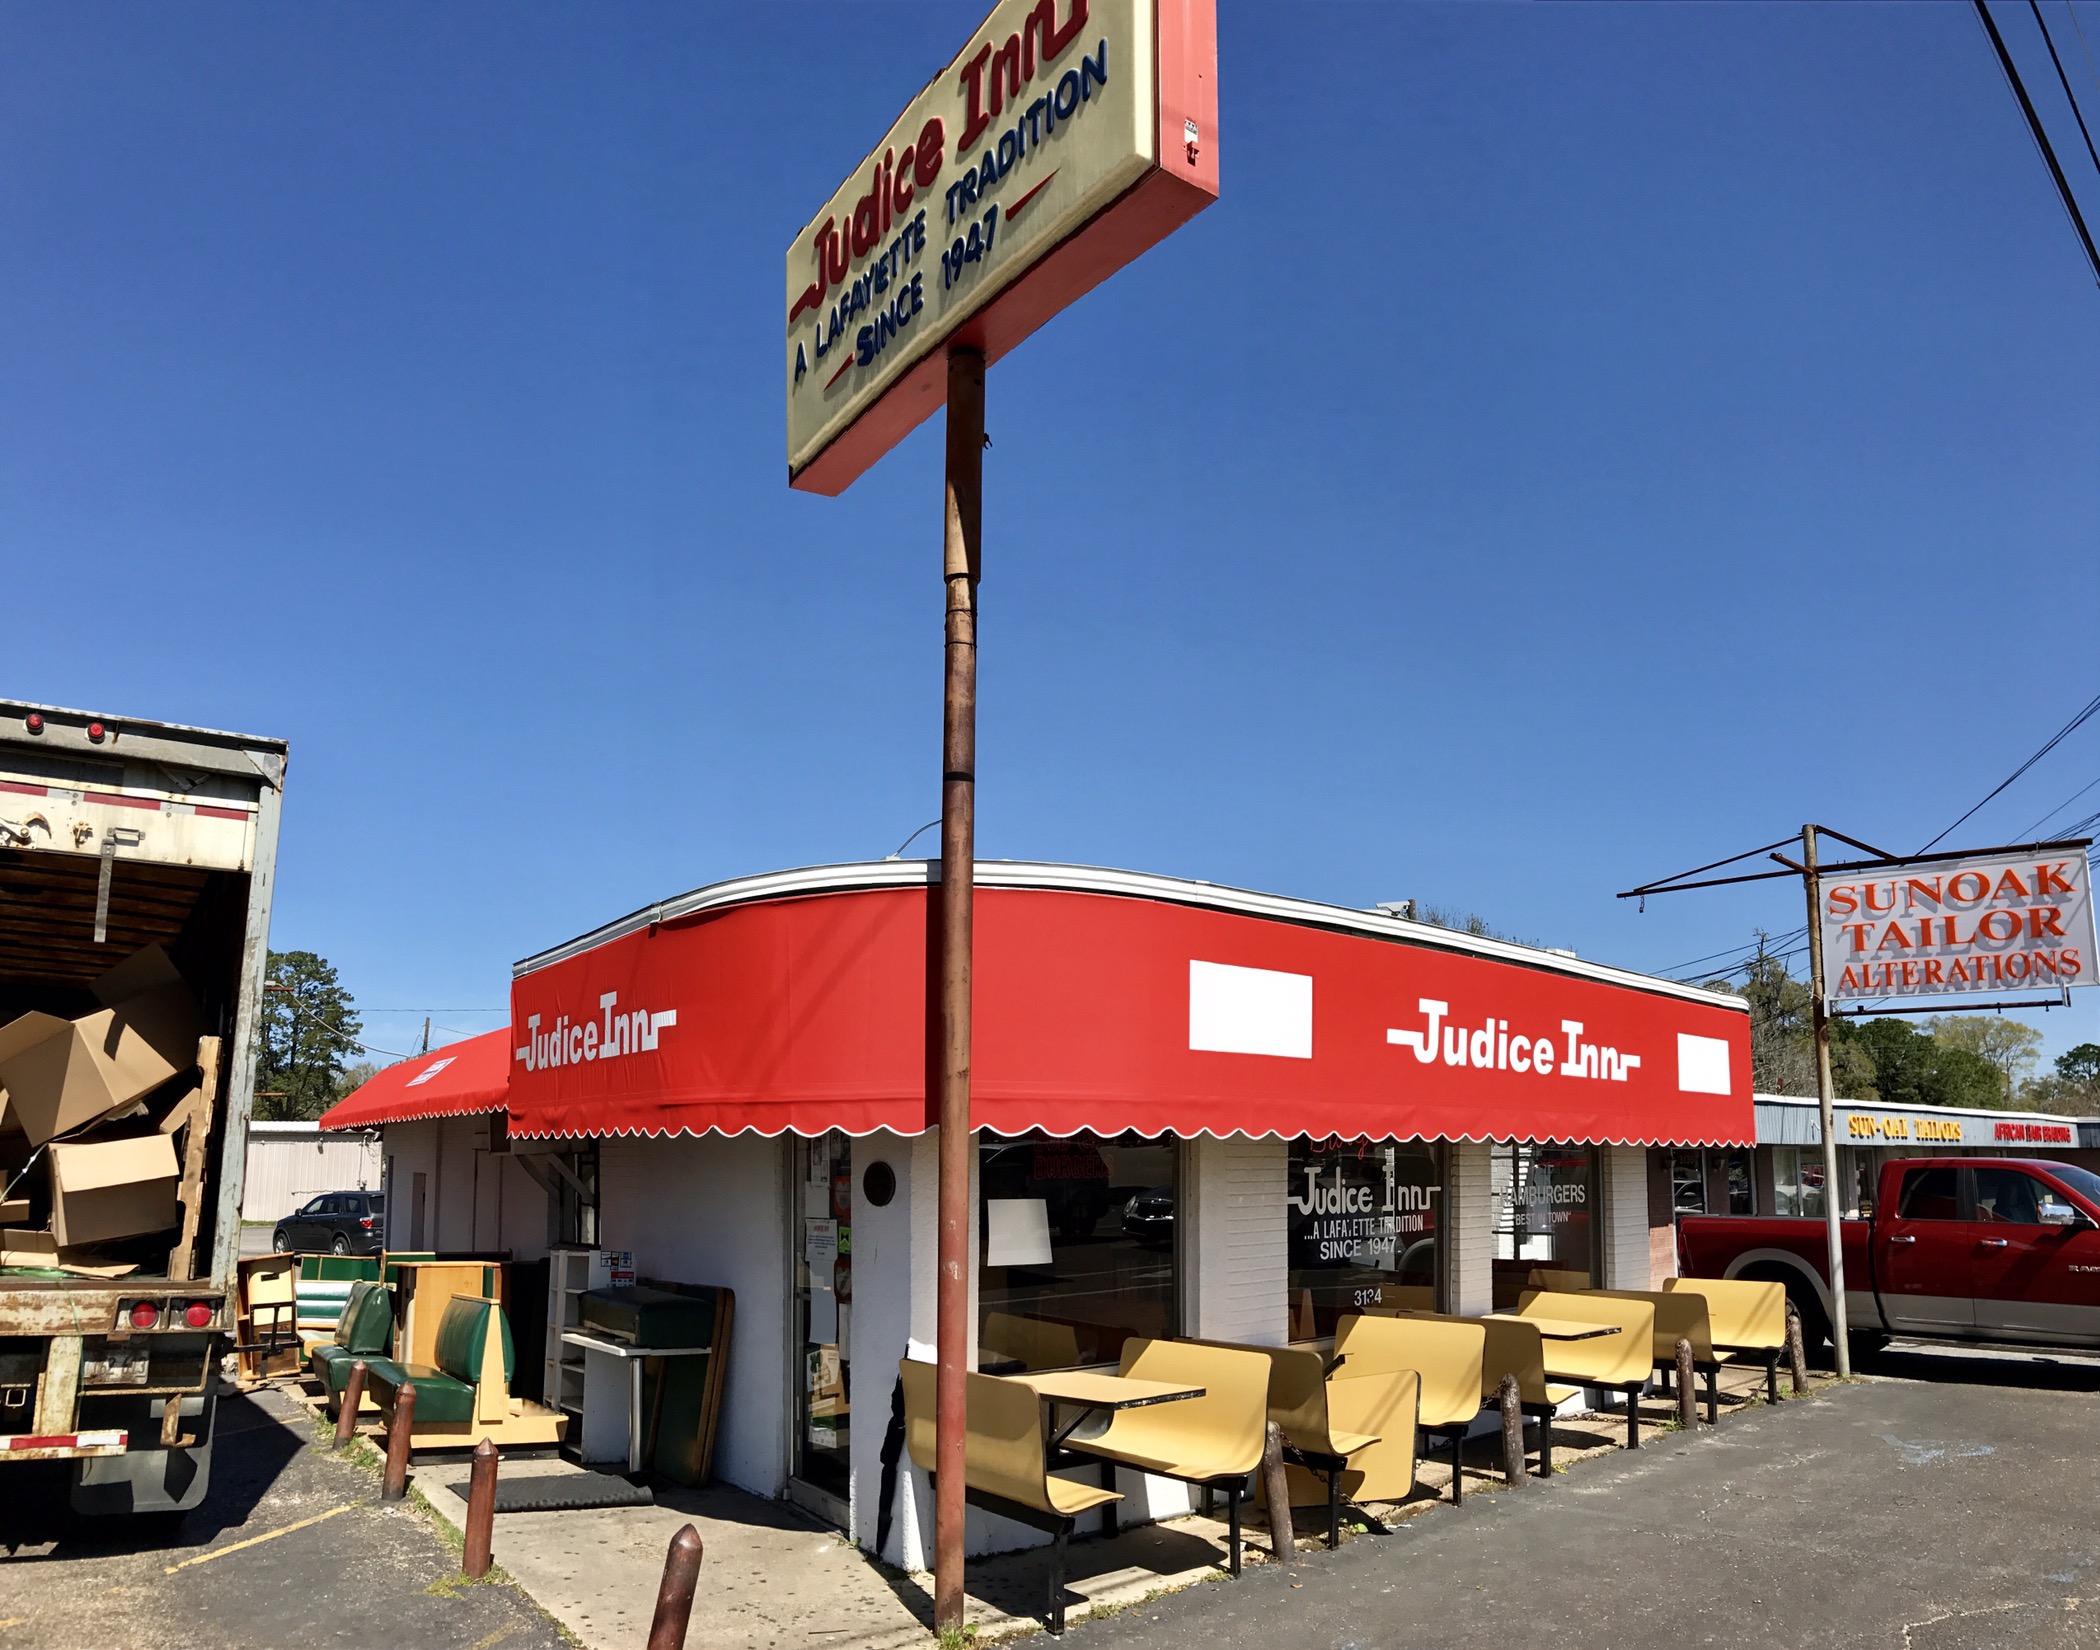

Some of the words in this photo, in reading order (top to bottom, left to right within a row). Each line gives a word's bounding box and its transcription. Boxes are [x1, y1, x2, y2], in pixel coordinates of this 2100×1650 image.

[790, 116, 945, 323] Judice
[958, 0, 1089, 152] Inn
[794, 340, 808, 382] A
[816, 206, 928, 358] LAFAYETTE
[945, 36, 1108, 225] TRADITION
[856, 269, 925, 367] SINCE
[941, 201, 1000, 290] 1947
[1829, 861, 2077, 915] SUNOAK
[1841, 906, 2068, 952] TAILOR
[1838, 948, 2083, 990] ALTERATIONS
[516, 1013, 598, 1072] Judice
[598, 990, 677, 1059] Inn
[1387, 997, 1555, 1075] Judice
[1560, 1019, 1641, 1082] Inn
[1848, 1114, 1909, 1138] SUN-OAK
[1914, 1118, 1962, 1141] TAILORS
[1994, 1123, 2025, 1140] AFRICAN
[1033, 1154, 1114, 1180] BURGERS
[1287, 1166, 1373, 1216] Judice
[1381, 1165, 1442, 1212] Inn
[1320, 1239, 1362, 1260] SINCE
